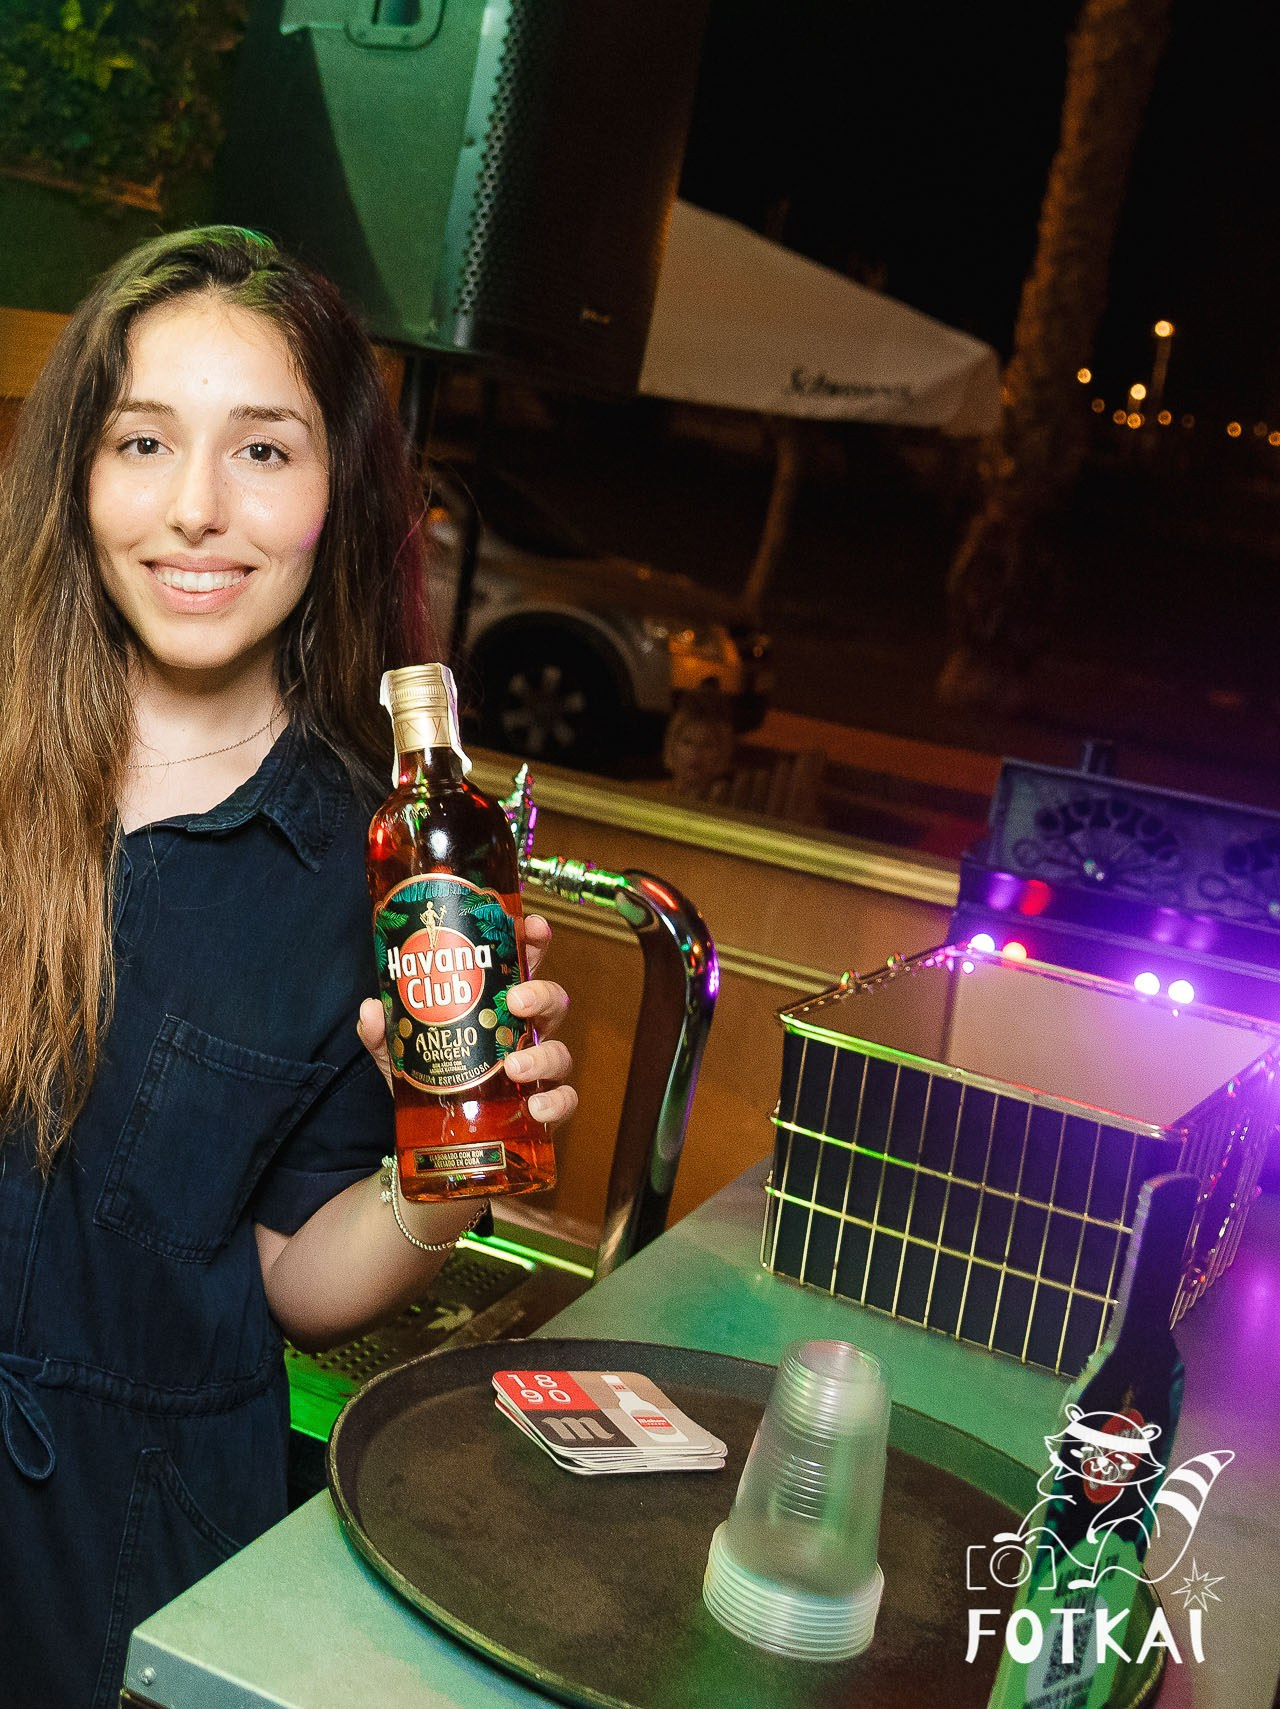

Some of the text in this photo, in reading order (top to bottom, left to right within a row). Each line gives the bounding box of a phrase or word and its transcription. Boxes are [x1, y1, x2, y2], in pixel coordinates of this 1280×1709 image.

[387, 944, 493, 981] Havana
[407, 973, 473, 1009] Club
[415, 1026, 478, 1054] AÑEJO
[423, 1046, 471, 1062] ORIGEN
[438, 1061, 491, 1086] ESPIRITUOSA
[459, 1151, 471, 1159] CON
[471, 1150, 484, 1158] RON
[464, 1157, 480, 1166] CUBA
